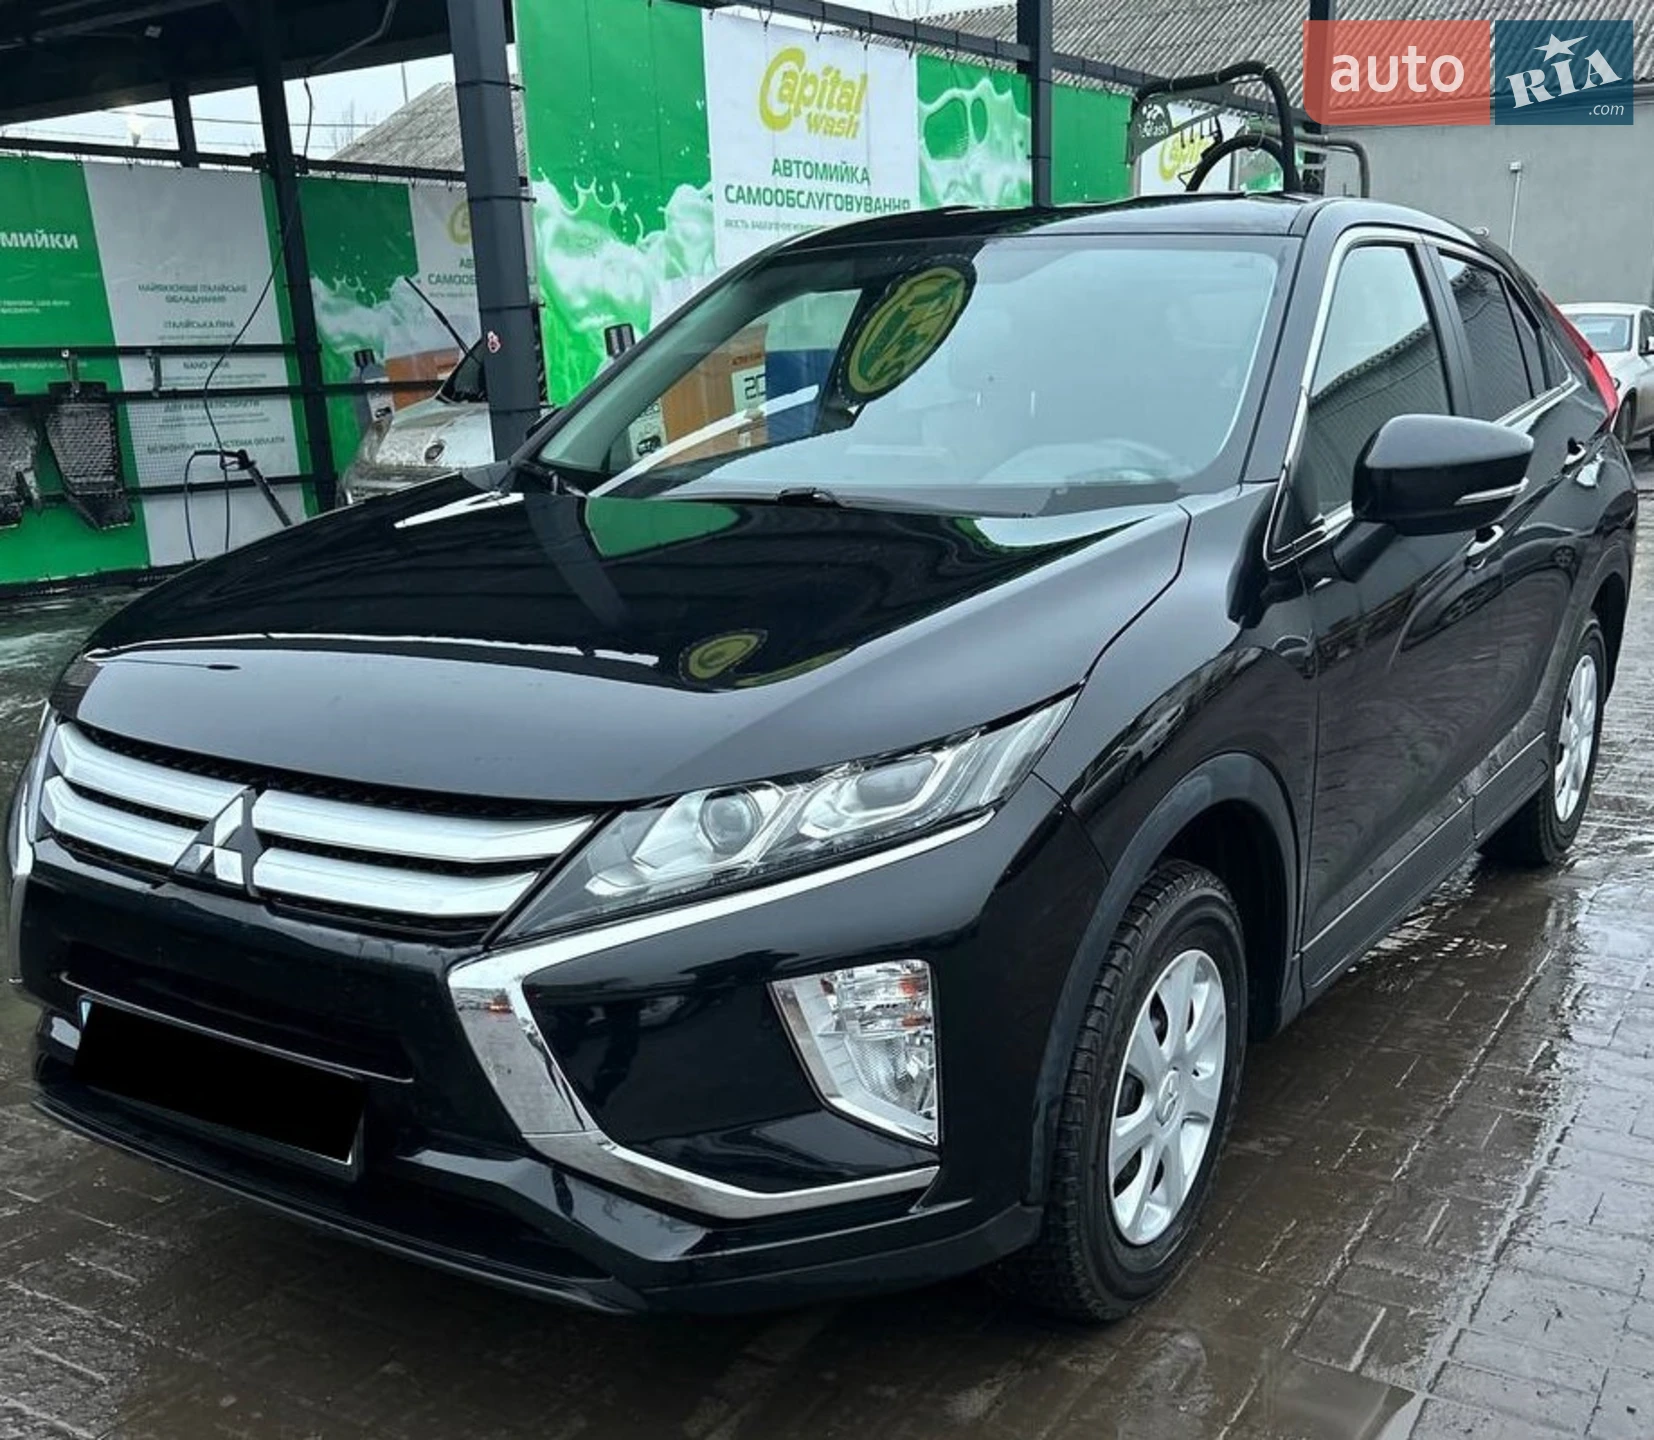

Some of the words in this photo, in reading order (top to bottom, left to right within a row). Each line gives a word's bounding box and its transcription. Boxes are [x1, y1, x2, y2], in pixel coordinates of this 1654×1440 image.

[760, 47, 868, 132] Capital
[807, 111, 860, 139] wash
[771, 157, 871, 186] АВТОМИЙКА
